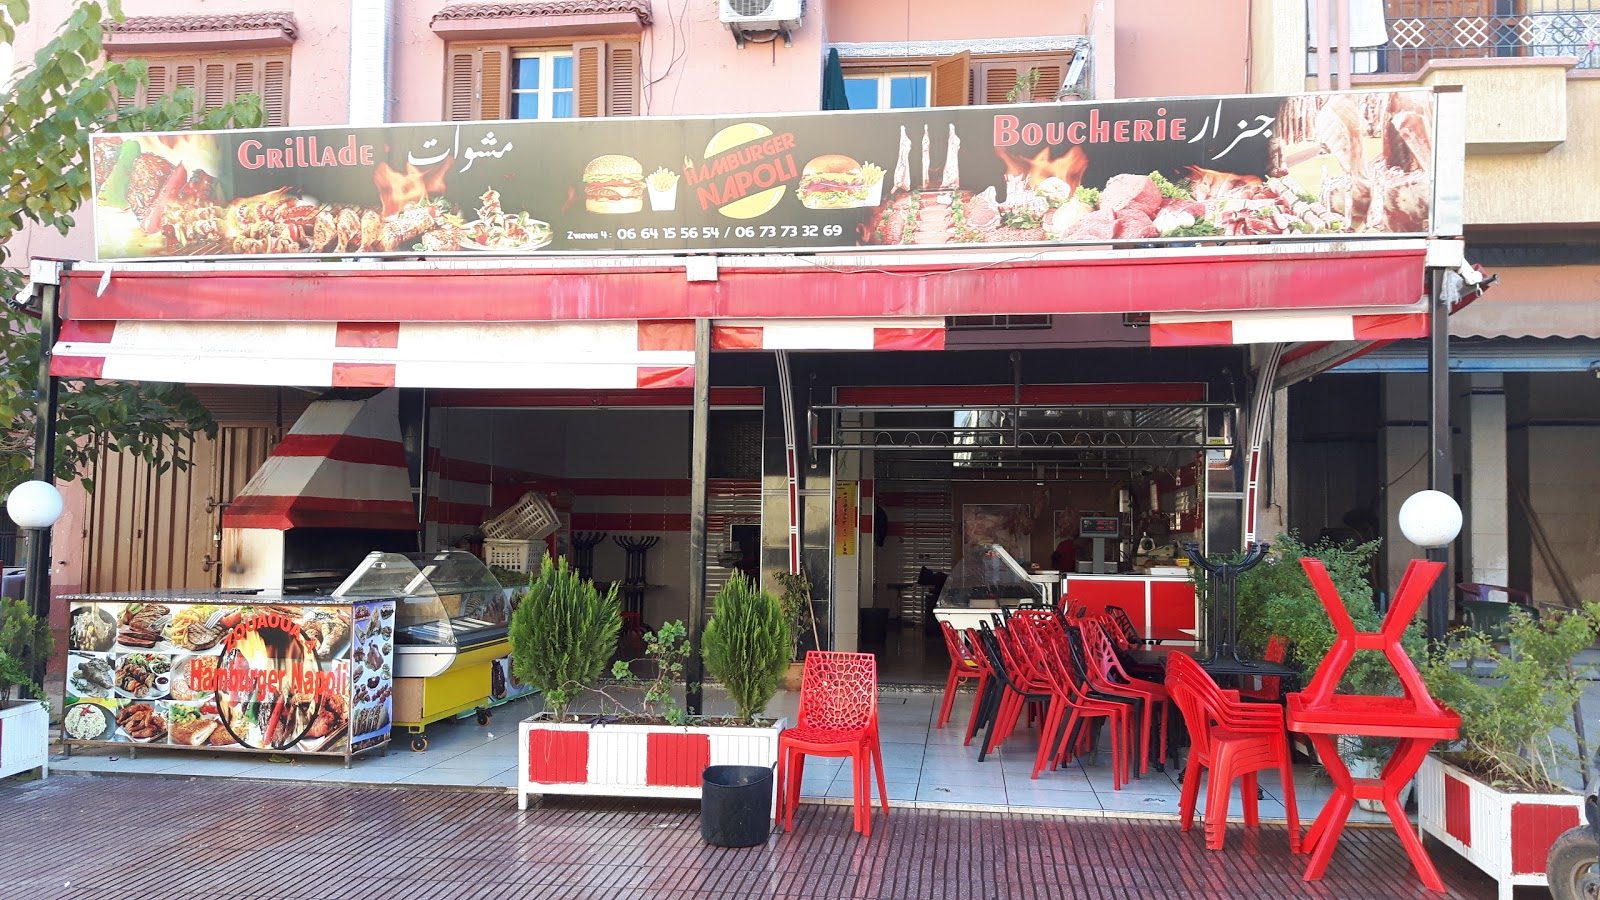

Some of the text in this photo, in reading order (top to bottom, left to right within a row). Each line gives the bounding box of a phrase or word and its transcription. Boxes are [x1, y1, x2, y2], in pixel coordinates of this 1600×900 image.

[683, 132, 796, 186] HAMBURGER
[697, 154, 798, 210] NAPOLI
[566, 231, 599, 240] Zwawa
[616, 227, 637, 240] 06
[640, 227, 659, 240] 64
[662, 227, 677, 240] 15
[680, 226, 699, 239] 56
[702, 226, 720, 239] 54
[734, 226, 755, 239] 06
[759, 225, 777, 238] 73
[780, 225, 799, 238] 73
[802, 225, 819, 238] 32
[822, 224, 843, 237] 69
[222, 611, 301, 653] ZOUAOUA
[190, 659, 347, 703] Hamburger Napoli
